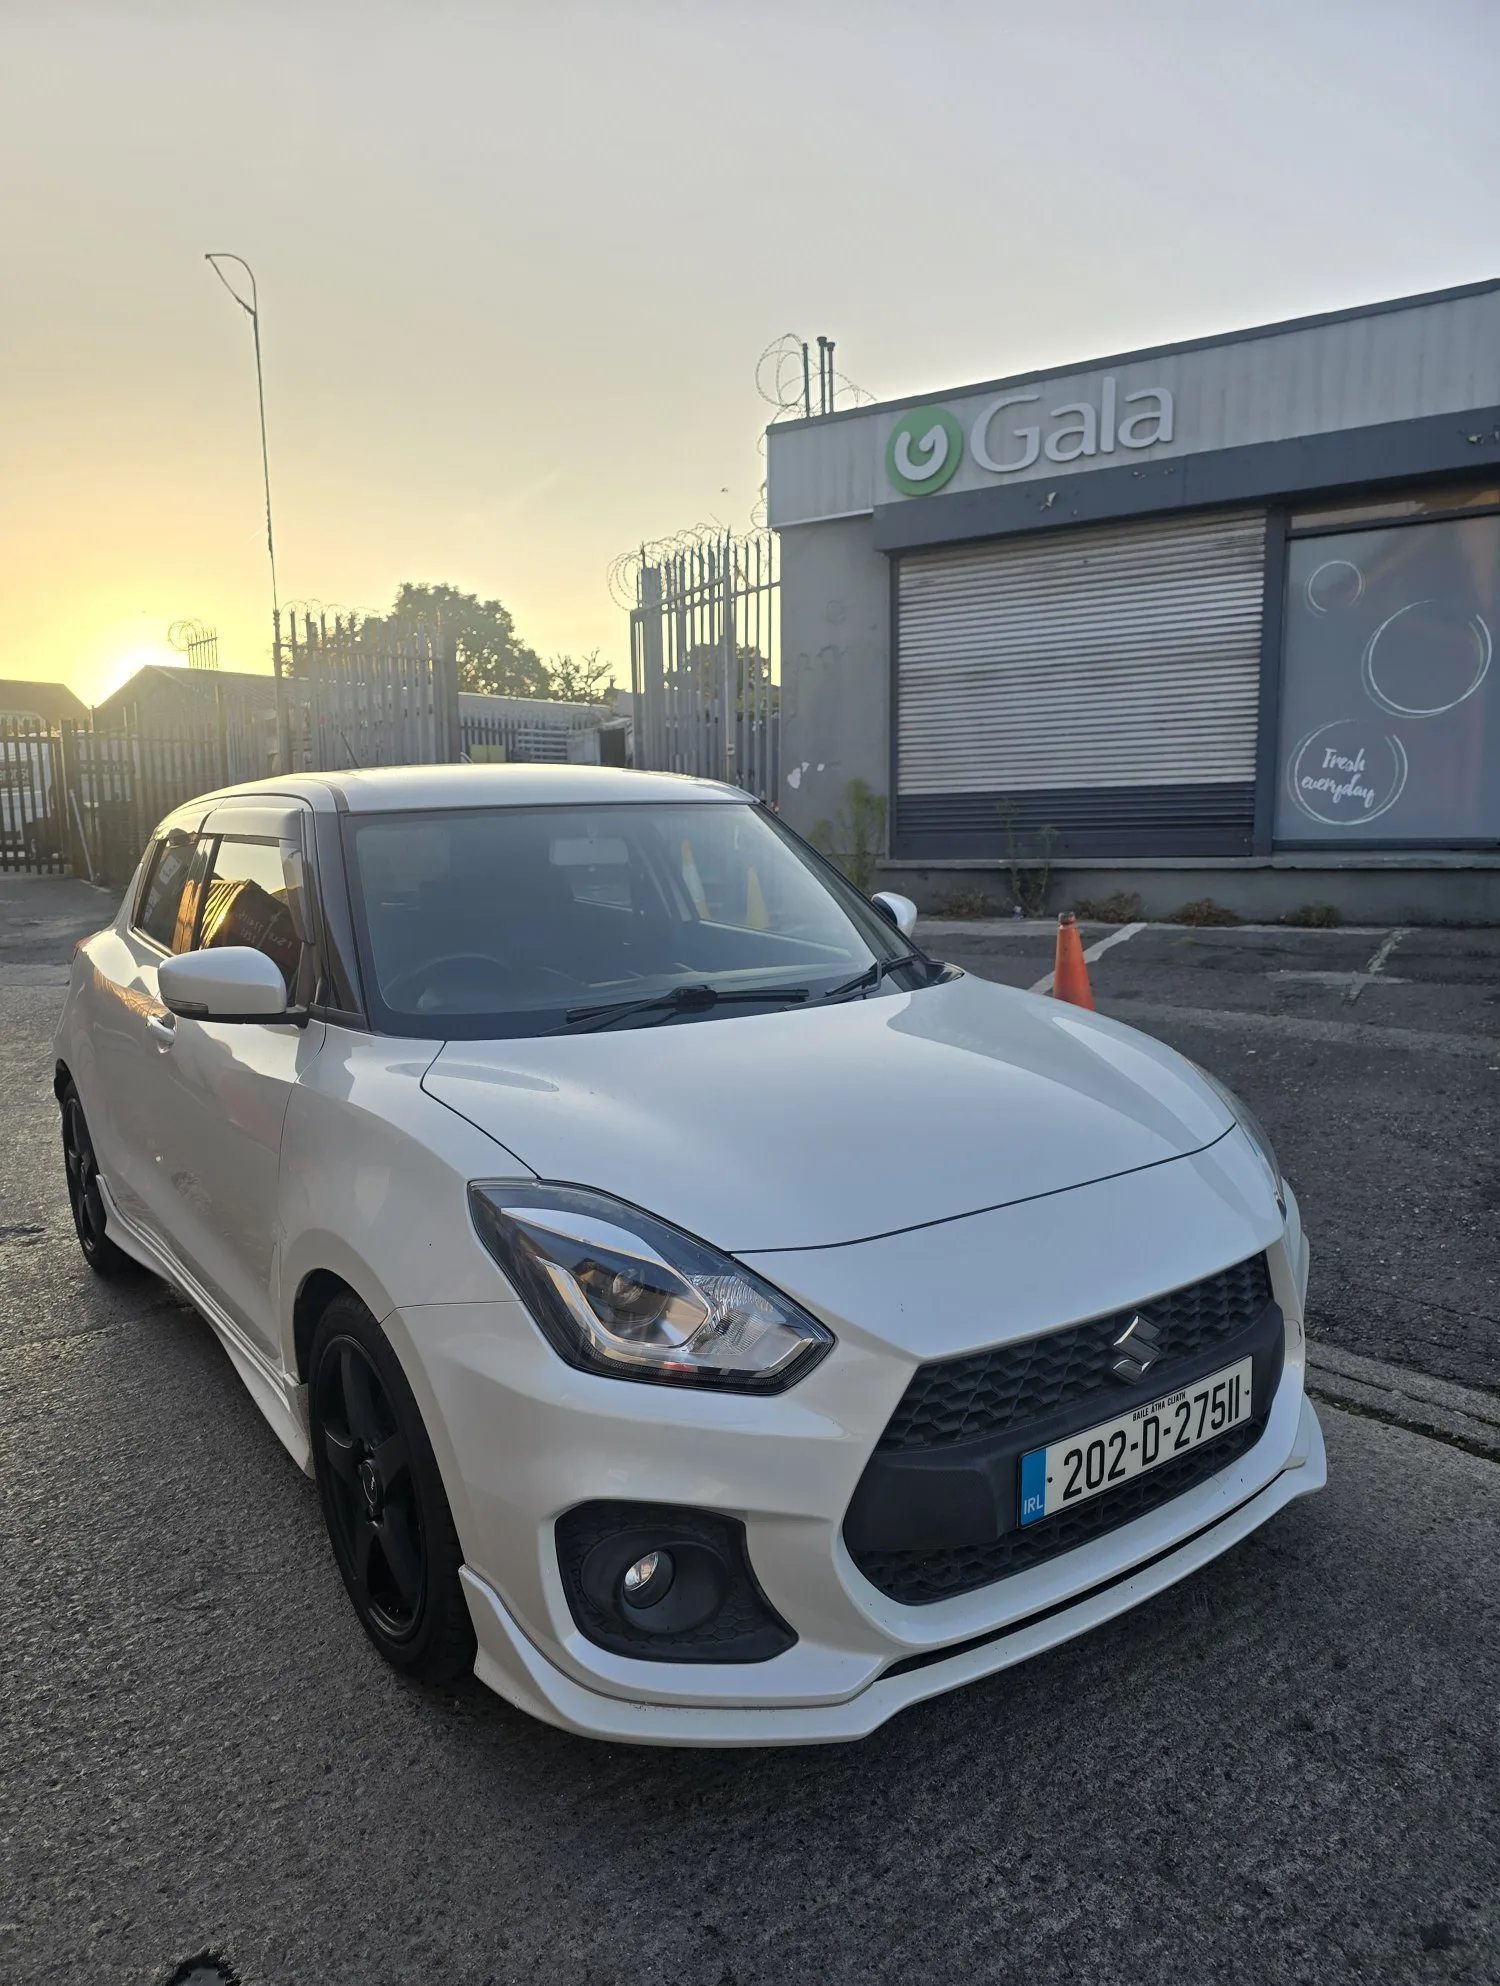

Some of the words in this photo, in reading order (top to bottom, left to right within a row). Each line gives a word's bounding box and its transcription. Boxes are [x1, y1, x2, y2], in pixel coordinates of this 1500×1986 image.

[969, 375, 1174, 474] Gala
[1321, 747, 1367, 773] Fresh
[1301, 773, 1376, 809] everyday
[1132, 1407, 1149, 1422] BAILE
[1167, 1391, 1186, 1406] CLIATH
[1062, 1374, 1241, 1502] 202-D-27511
[1023, 1497, 1044, 1515] IRL
